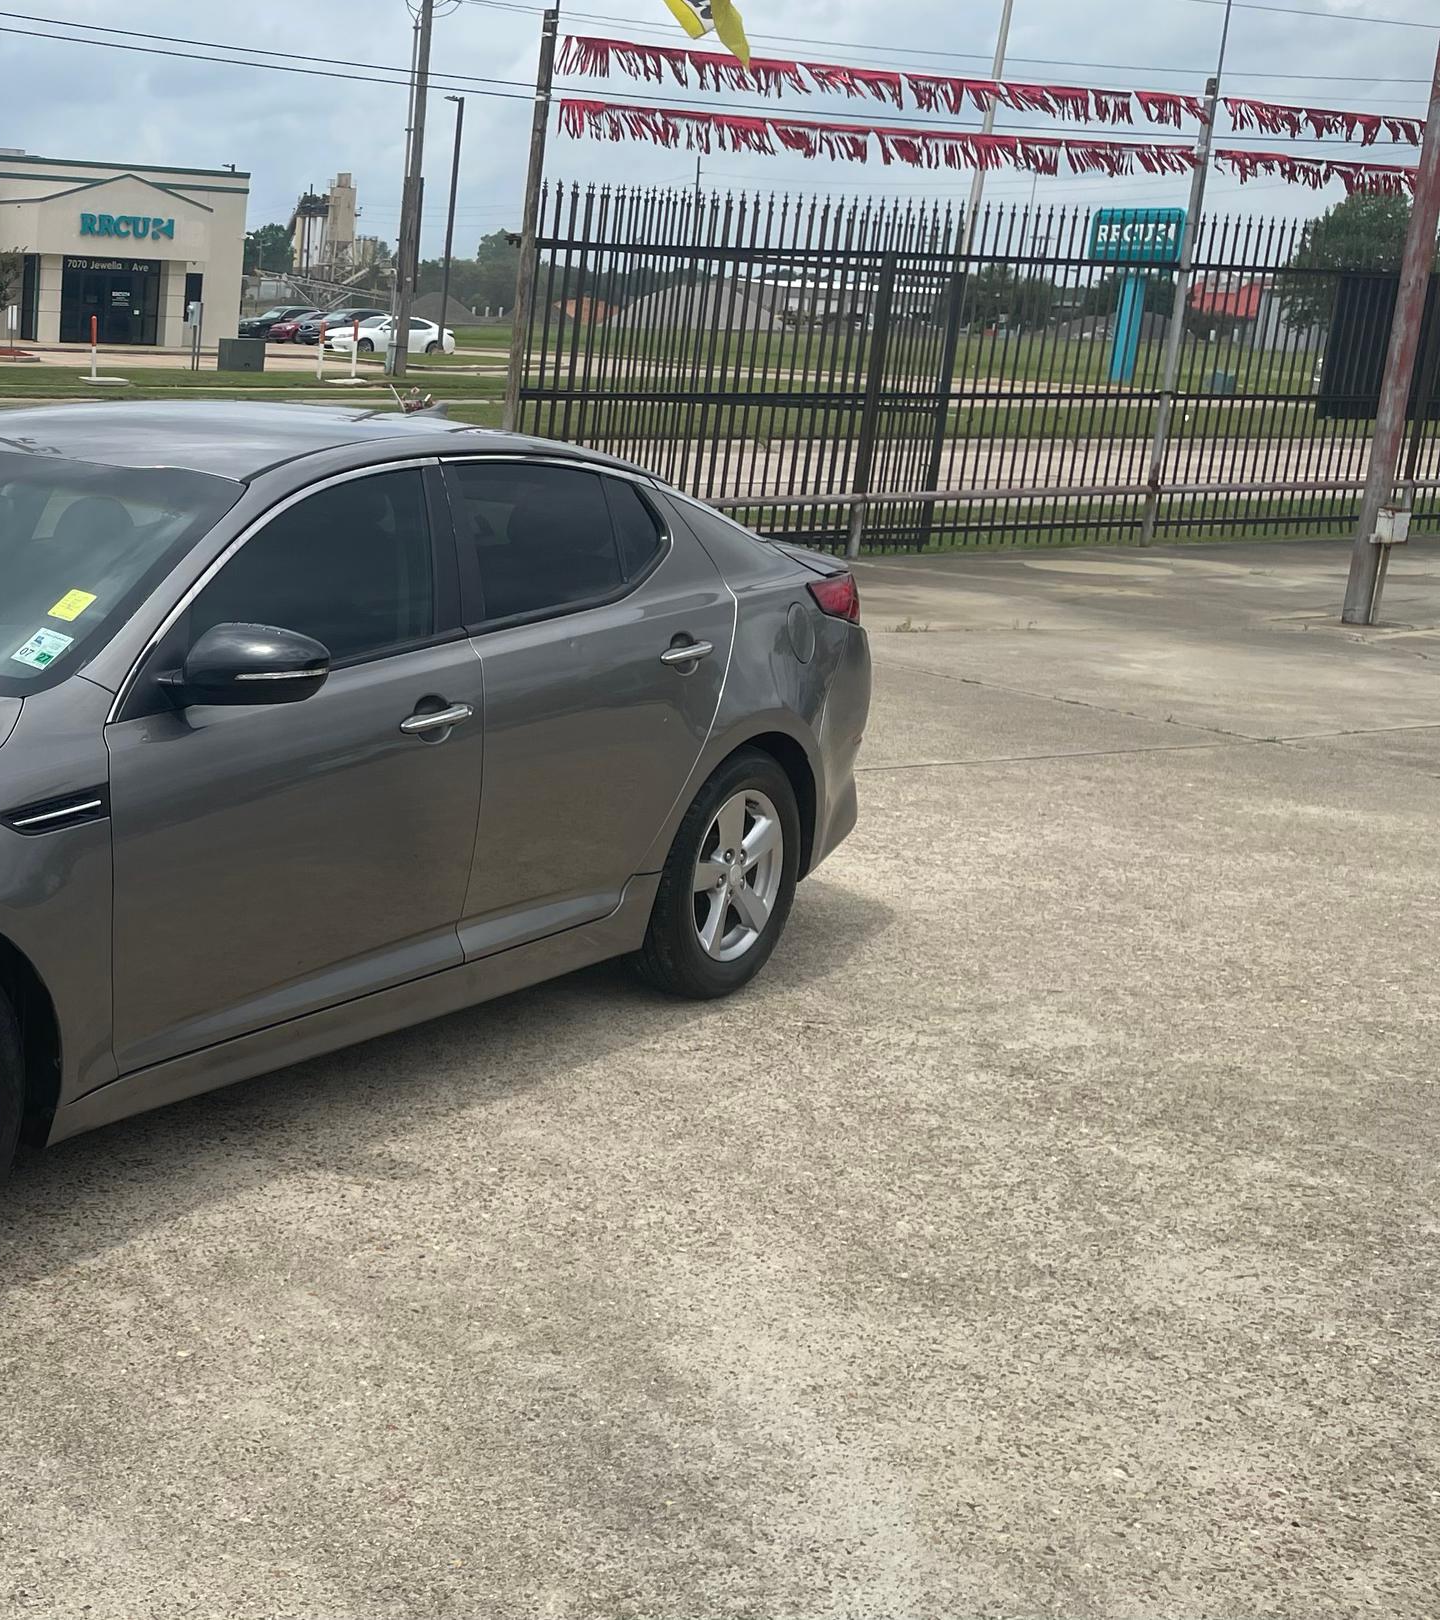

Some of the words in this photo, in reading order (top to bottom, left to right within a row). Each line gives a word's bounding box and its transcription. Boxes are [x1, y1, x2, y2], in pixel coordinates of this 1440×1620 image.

[67, 259, 87, 269] 7070
[90, 261, 122, 270] Jewella
[131, 263, 149, 272] Ave
